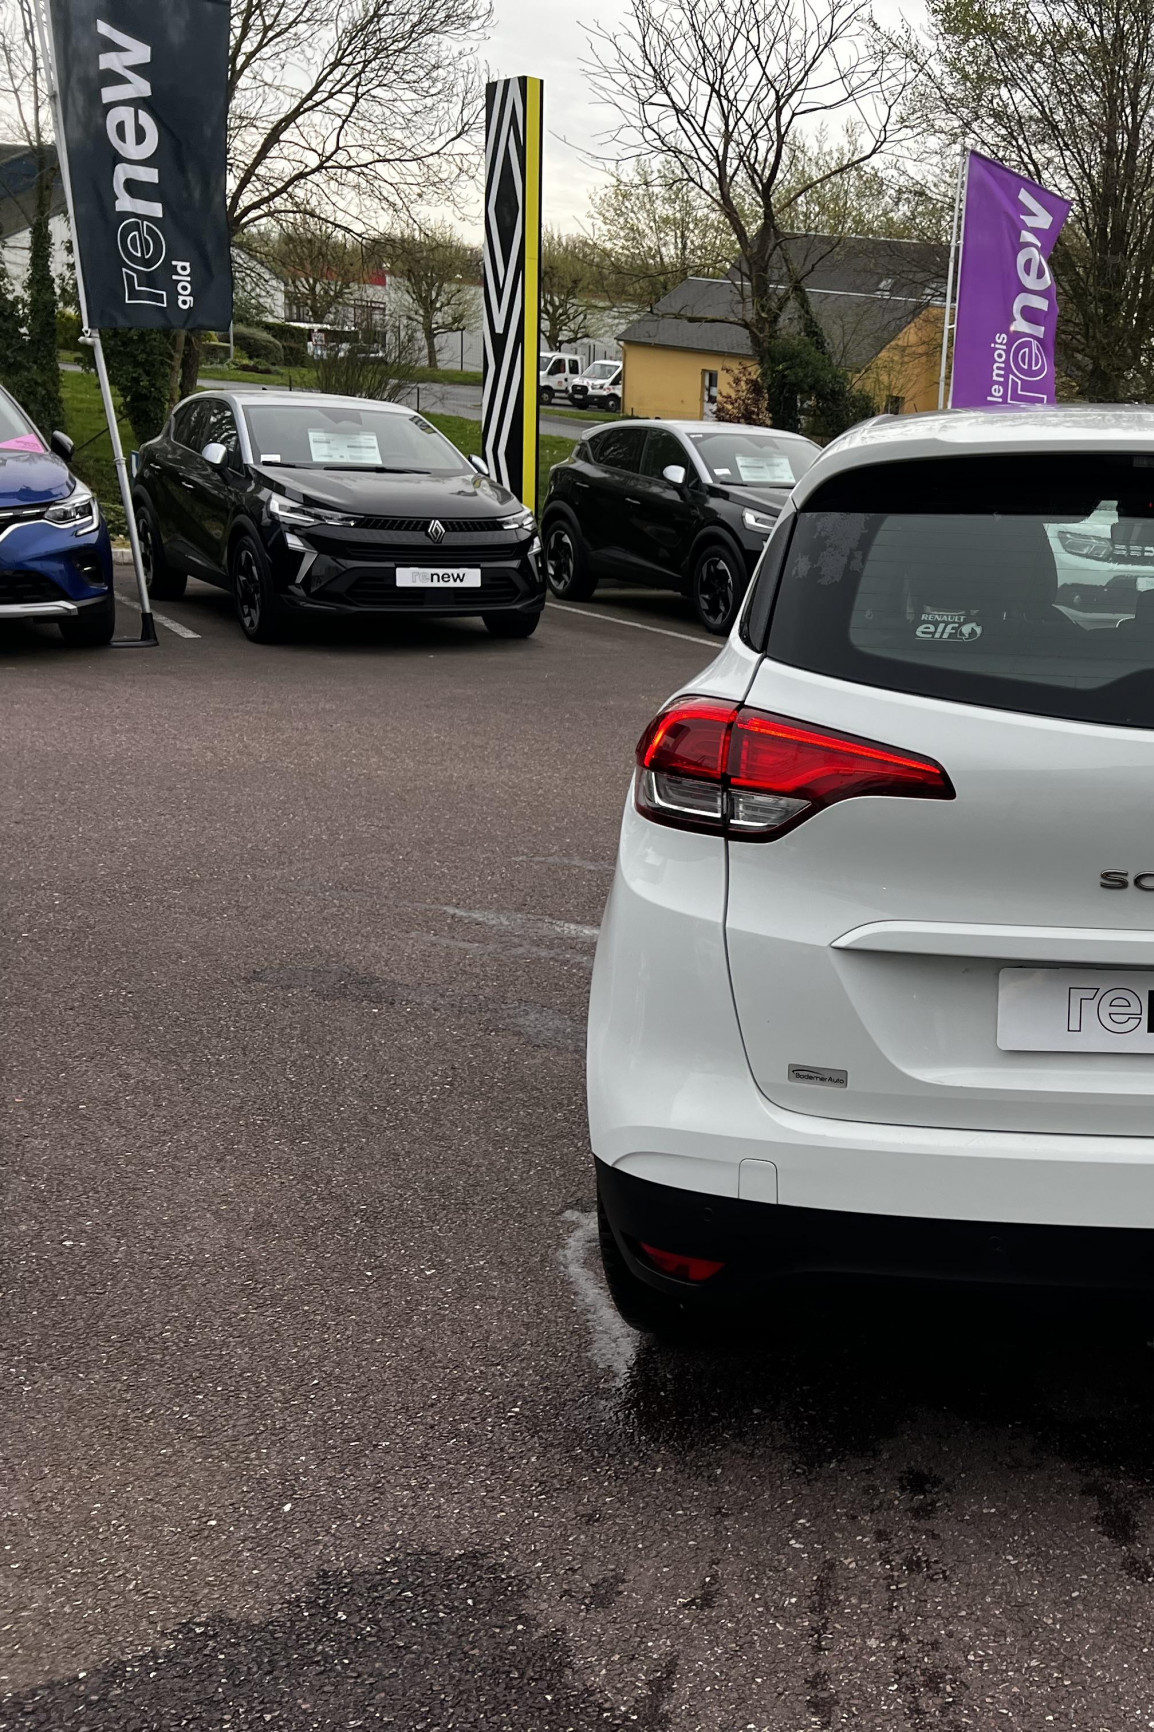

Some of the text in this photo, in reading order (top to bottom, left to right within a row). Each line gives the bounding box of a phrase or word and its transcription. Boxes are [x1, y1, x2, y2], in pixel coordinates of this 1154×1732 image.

[97, 18, 167, 307] renew
[171, 260, 194, 310] gold
[987, 332, 1008, 402] le mois
[411, 572, 466, 584] renew
[921, 614, 966, 622] RENAULT
[915, 623, 959, 639] elf
[827, 1076, 845, 1084] Auto
